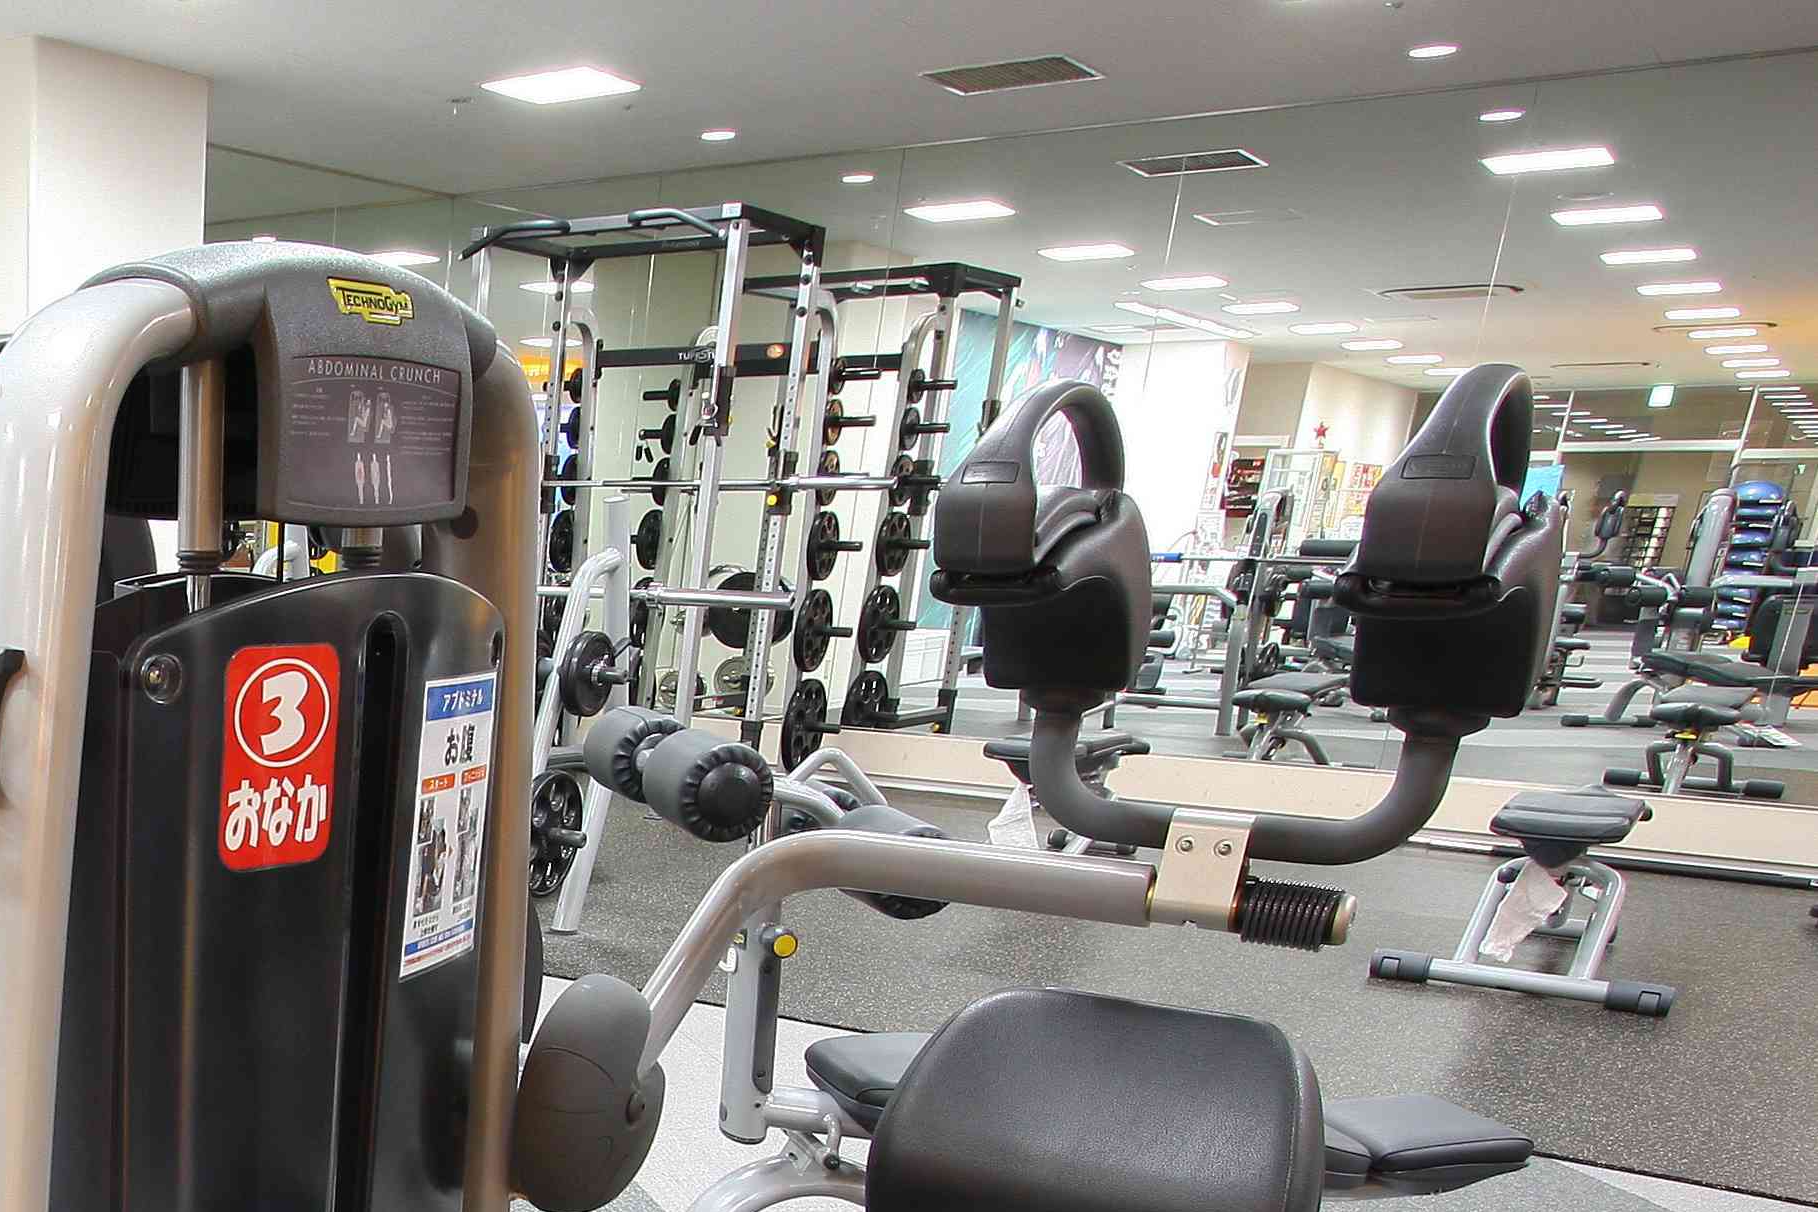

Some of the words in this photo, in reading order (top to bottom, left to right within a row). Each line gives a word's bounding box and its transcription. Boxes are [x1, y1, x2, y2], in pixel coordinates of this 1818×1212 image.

[308, 359, 384, 379] ABDOMINAL
[390, 365, 441, 384] CRUNCH
[442, 688, 484, 712] アブドミナル
[444, 723, 475, 766] お腹
[224, 773, 327, 852] おなか
